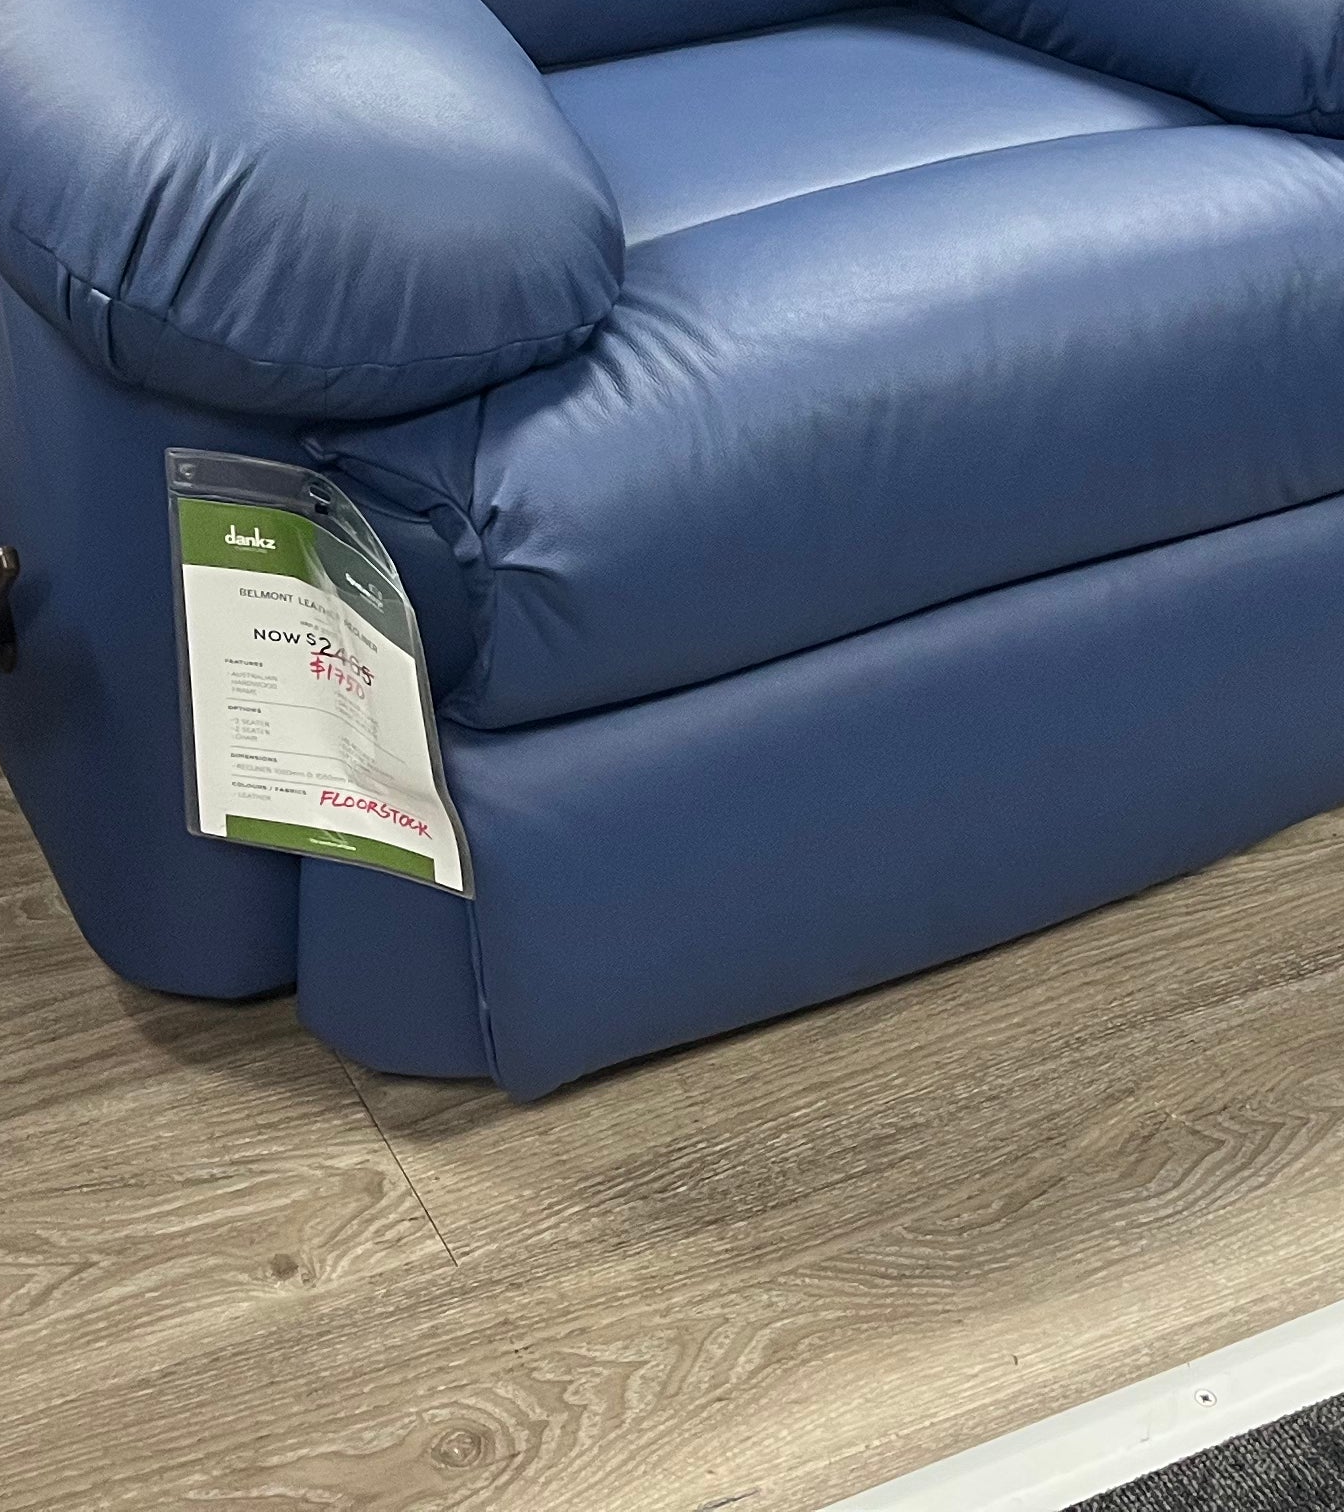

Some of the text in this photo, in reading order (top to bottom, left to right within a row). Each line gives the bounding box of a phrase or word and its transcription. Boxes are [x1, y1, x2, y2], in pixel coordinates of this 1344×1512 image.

[224, 524, 276, 550] dankz
[239, 587, 293, 603] BELMONT
[253, 628, 301, 644] NOW
[319, 790, 433, 840] FLOORSTOCK
